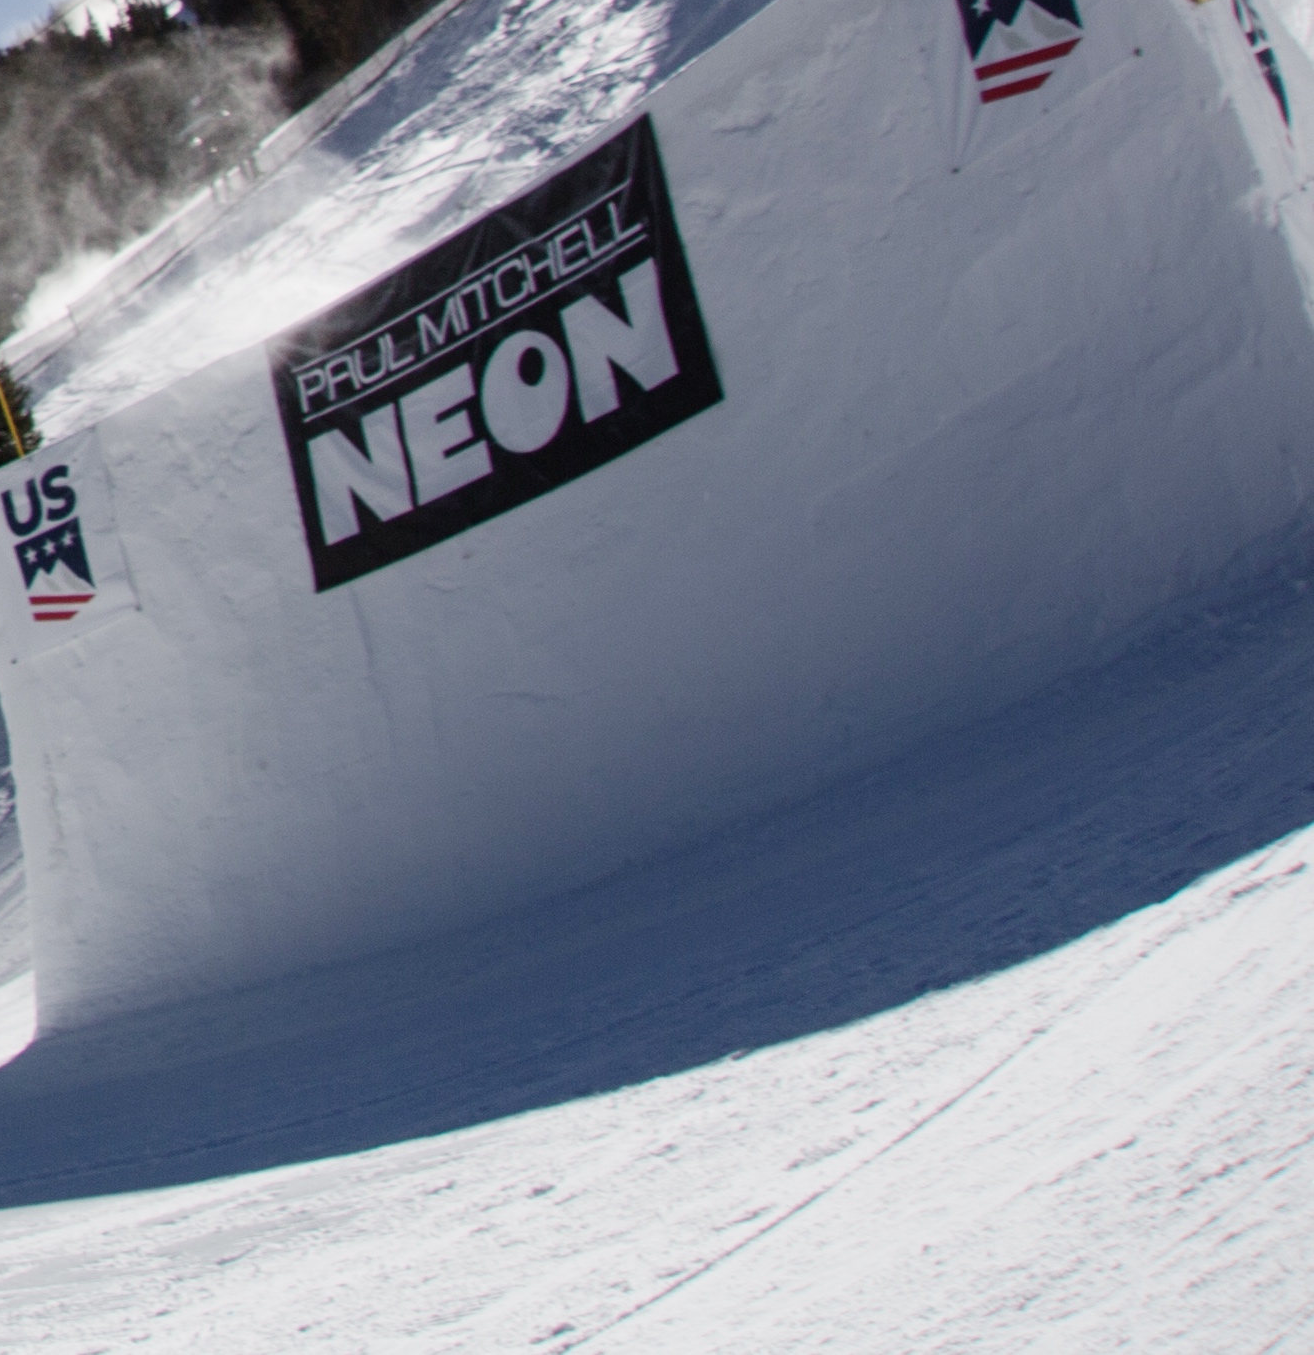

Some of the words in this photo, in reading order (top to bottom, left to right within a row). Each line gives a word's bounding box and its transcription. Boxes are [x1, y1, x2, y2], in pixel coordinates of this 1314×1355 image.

[296, 332, 416, 413] PAUL
[417, 201, 645, 352] MITCHELL
[306, 258, 680, 545] NEON
[1, 464, 77, 537] US
